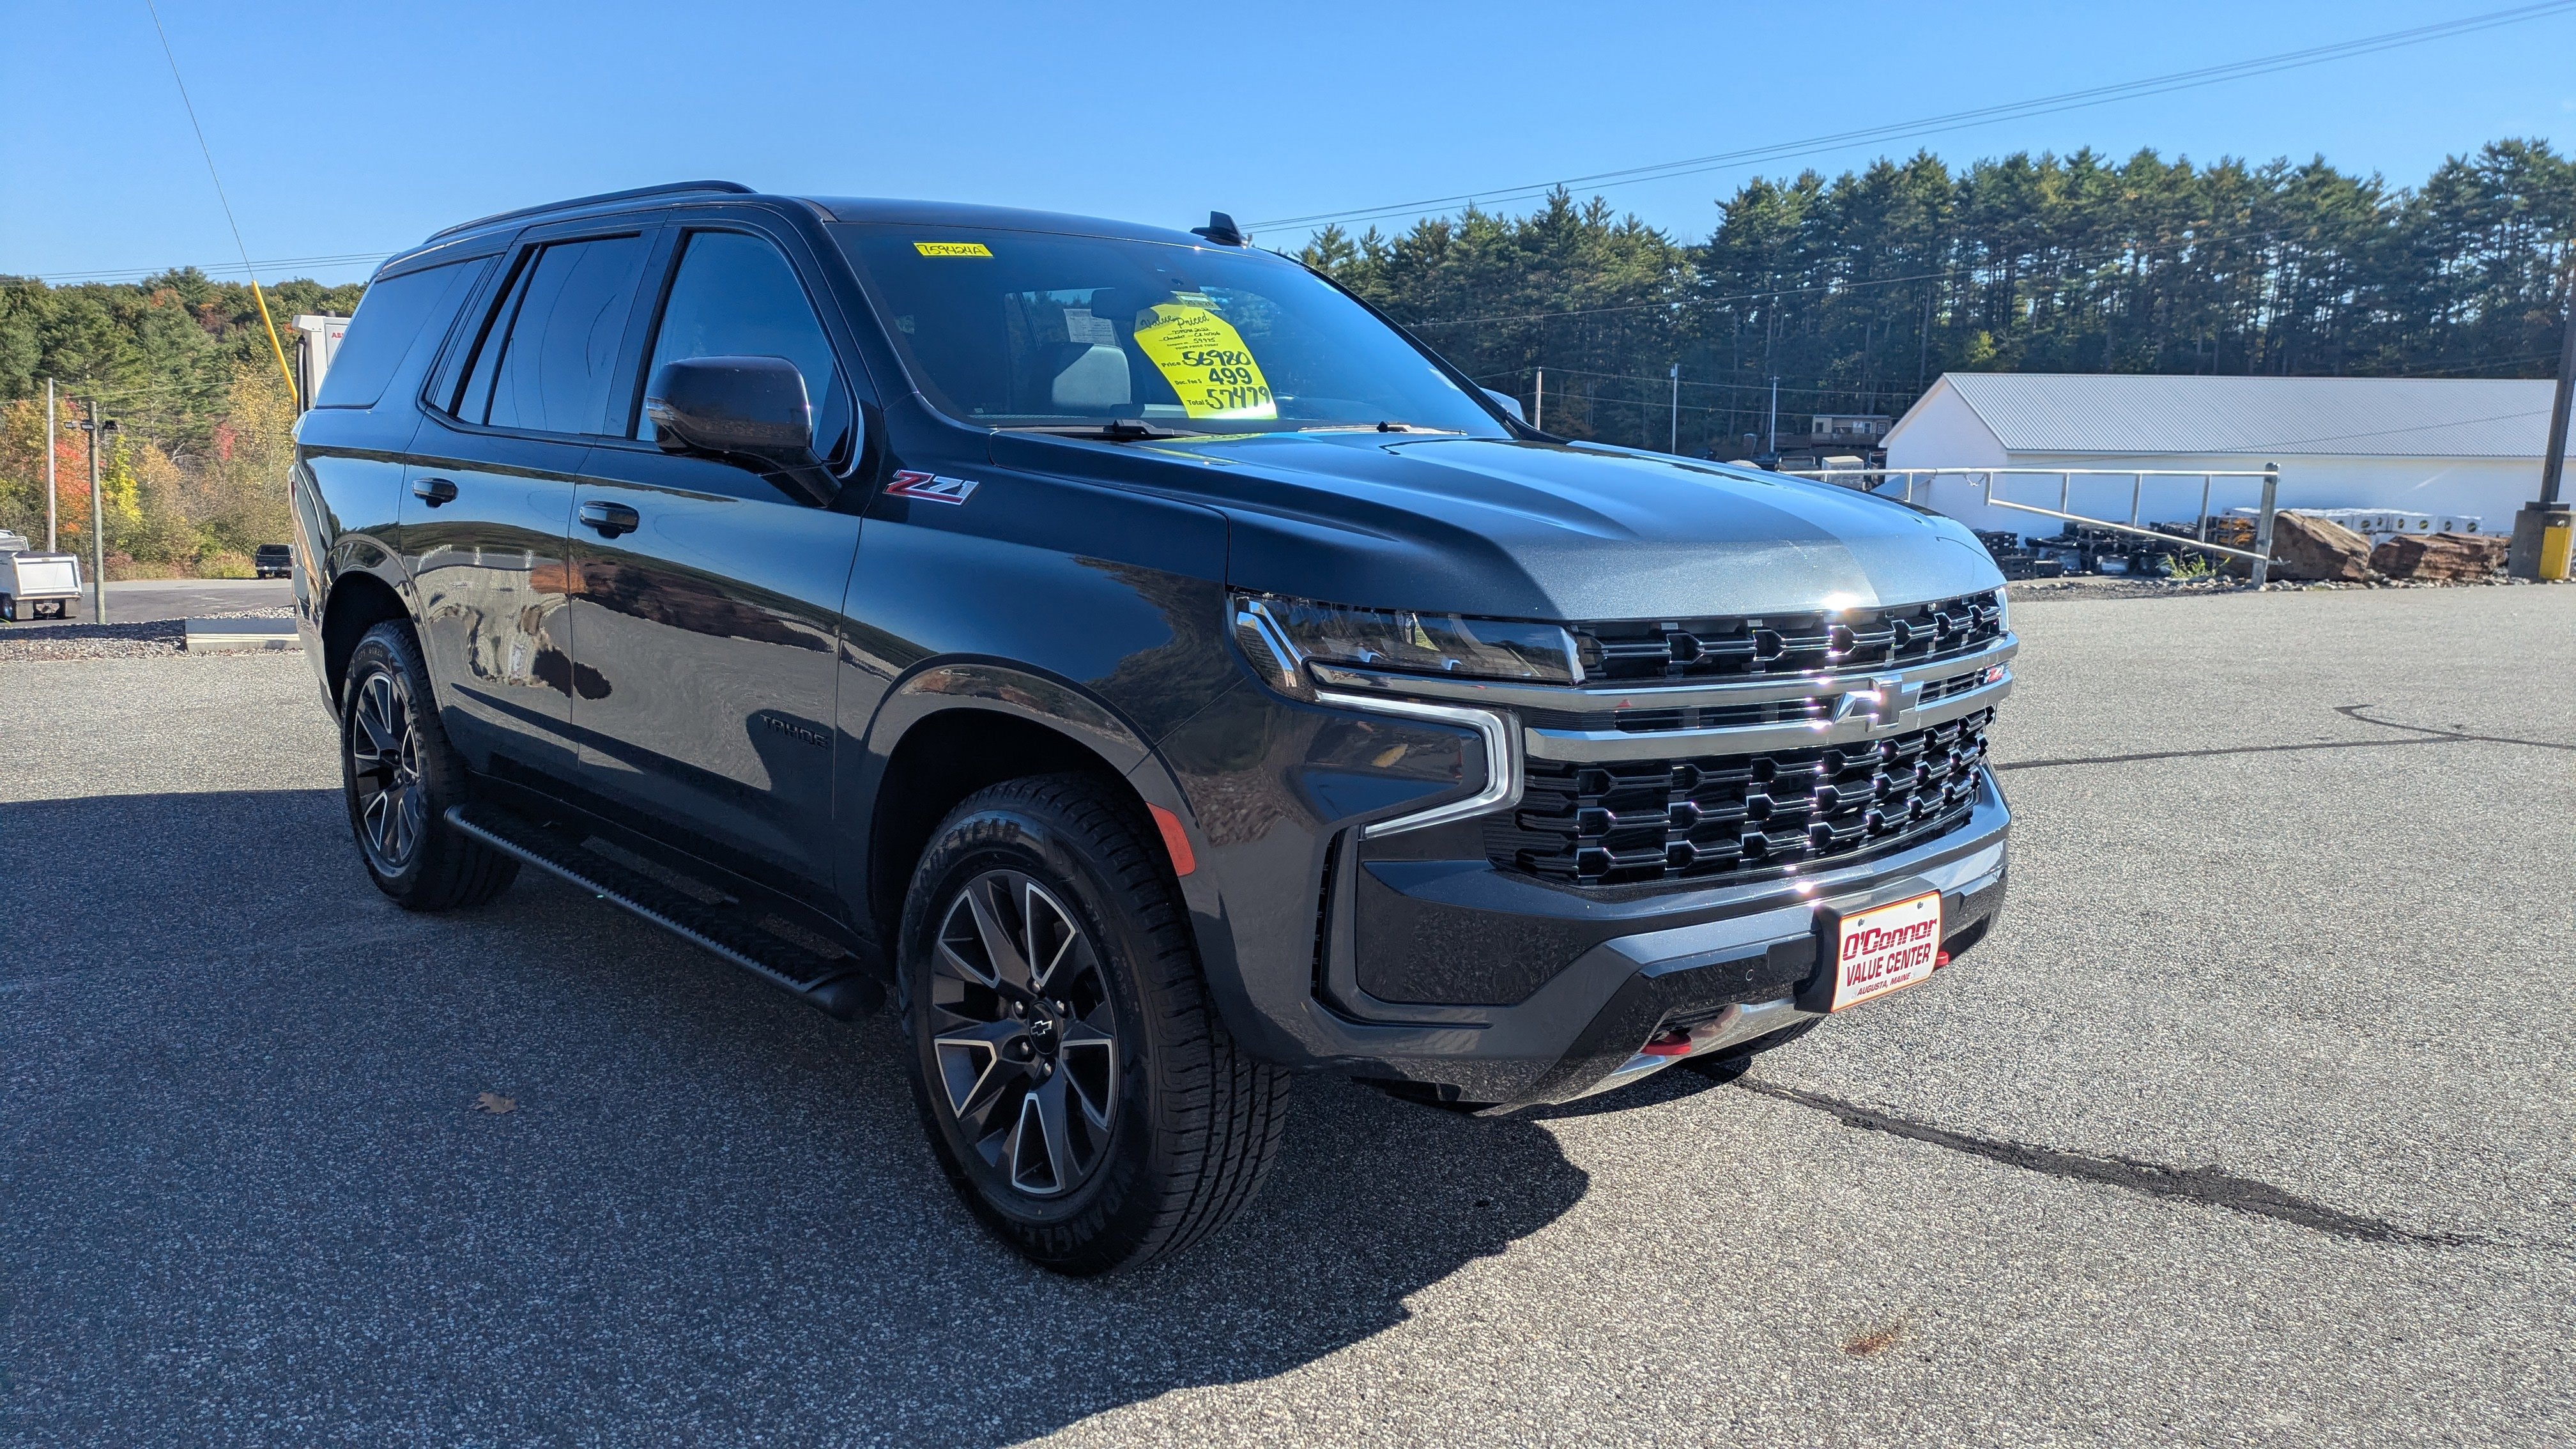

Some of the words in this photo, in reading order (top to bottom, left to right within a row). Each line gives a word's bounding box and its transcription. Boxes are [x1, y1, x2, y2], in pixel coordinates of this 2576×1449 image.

[1140, 315, 1174, 328] Value
[1174, 312, 1209, 329] Priced
[1161, 360, 1181, 368] Price
[1208, 367, 1253, 385] 499
[882, 469, 979, 505] Z71
[760, 714, 829, 750] TAHOE
[1843, 918, 1937, 962] O'Connor
[1846, 956, 1884, 987] VALUE
[1886, 942, 1931, 974] CENTER
[1857, 981, 1888, 996] AUGUSTA,
[1890, 972, 1912, 986] MAINE
